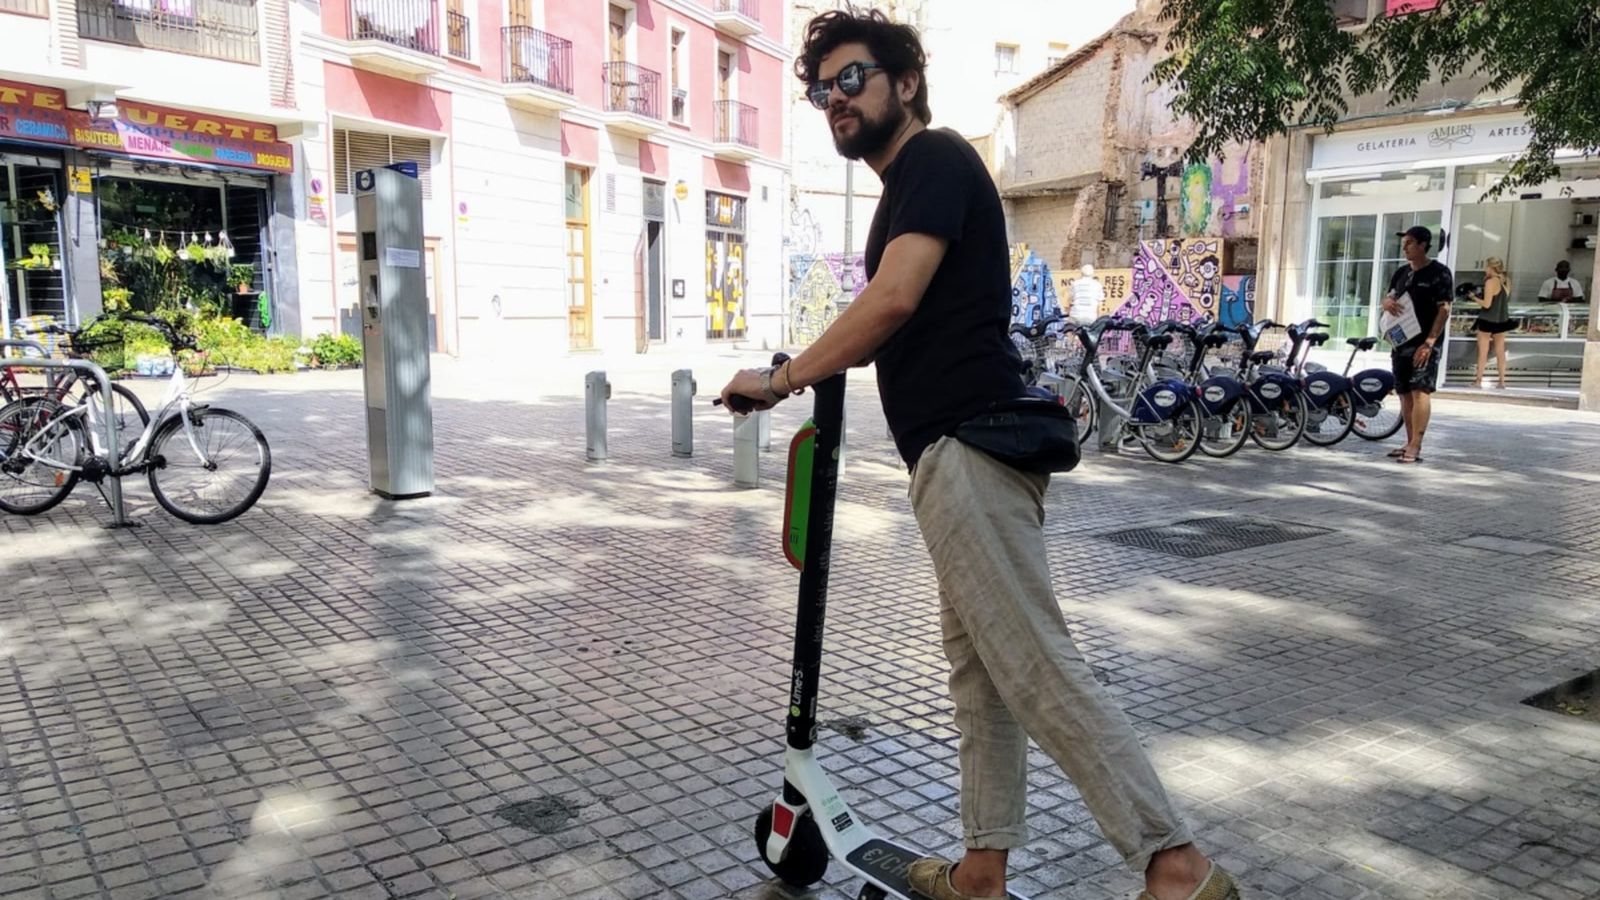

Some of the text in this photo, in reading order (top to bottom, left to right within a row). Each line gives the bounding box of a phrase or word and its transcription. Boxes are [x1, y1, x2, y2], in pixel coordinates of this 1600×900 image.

[15, 119, 69, 140] CERAMICA
[74, 128, 122, 147] BISUTERIA
[128, 136, 171, 153] MENAJE
[257, 153, 291, 168] DROGUERIA
[1357, 137, 1416, 151] GELATERIA
